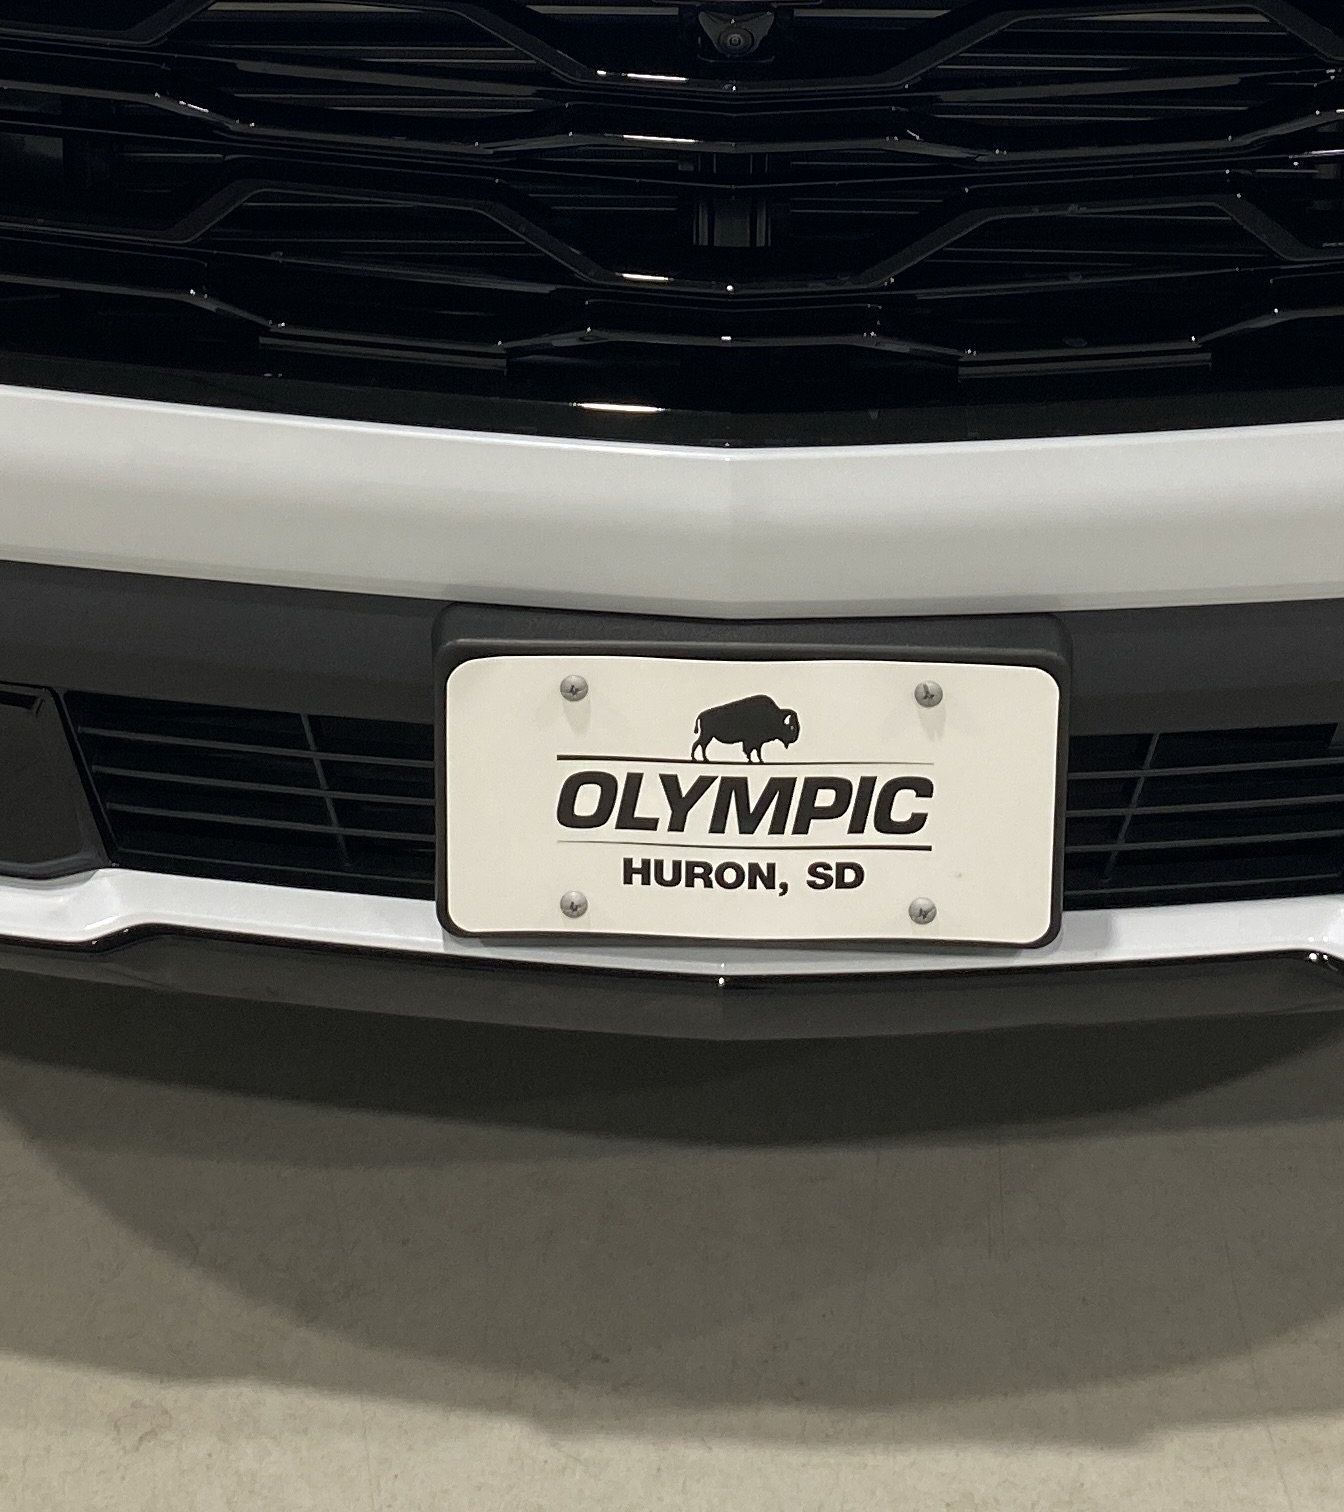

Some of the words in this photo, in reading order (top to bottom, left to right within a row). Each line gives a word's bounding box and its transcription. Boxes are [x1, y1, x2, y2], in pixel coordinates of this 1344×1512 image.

[556, 770, 935, 836] OLYMPIC
[622, 857, 789, 897] HURON,
[806, 862, 866, 890] SD
